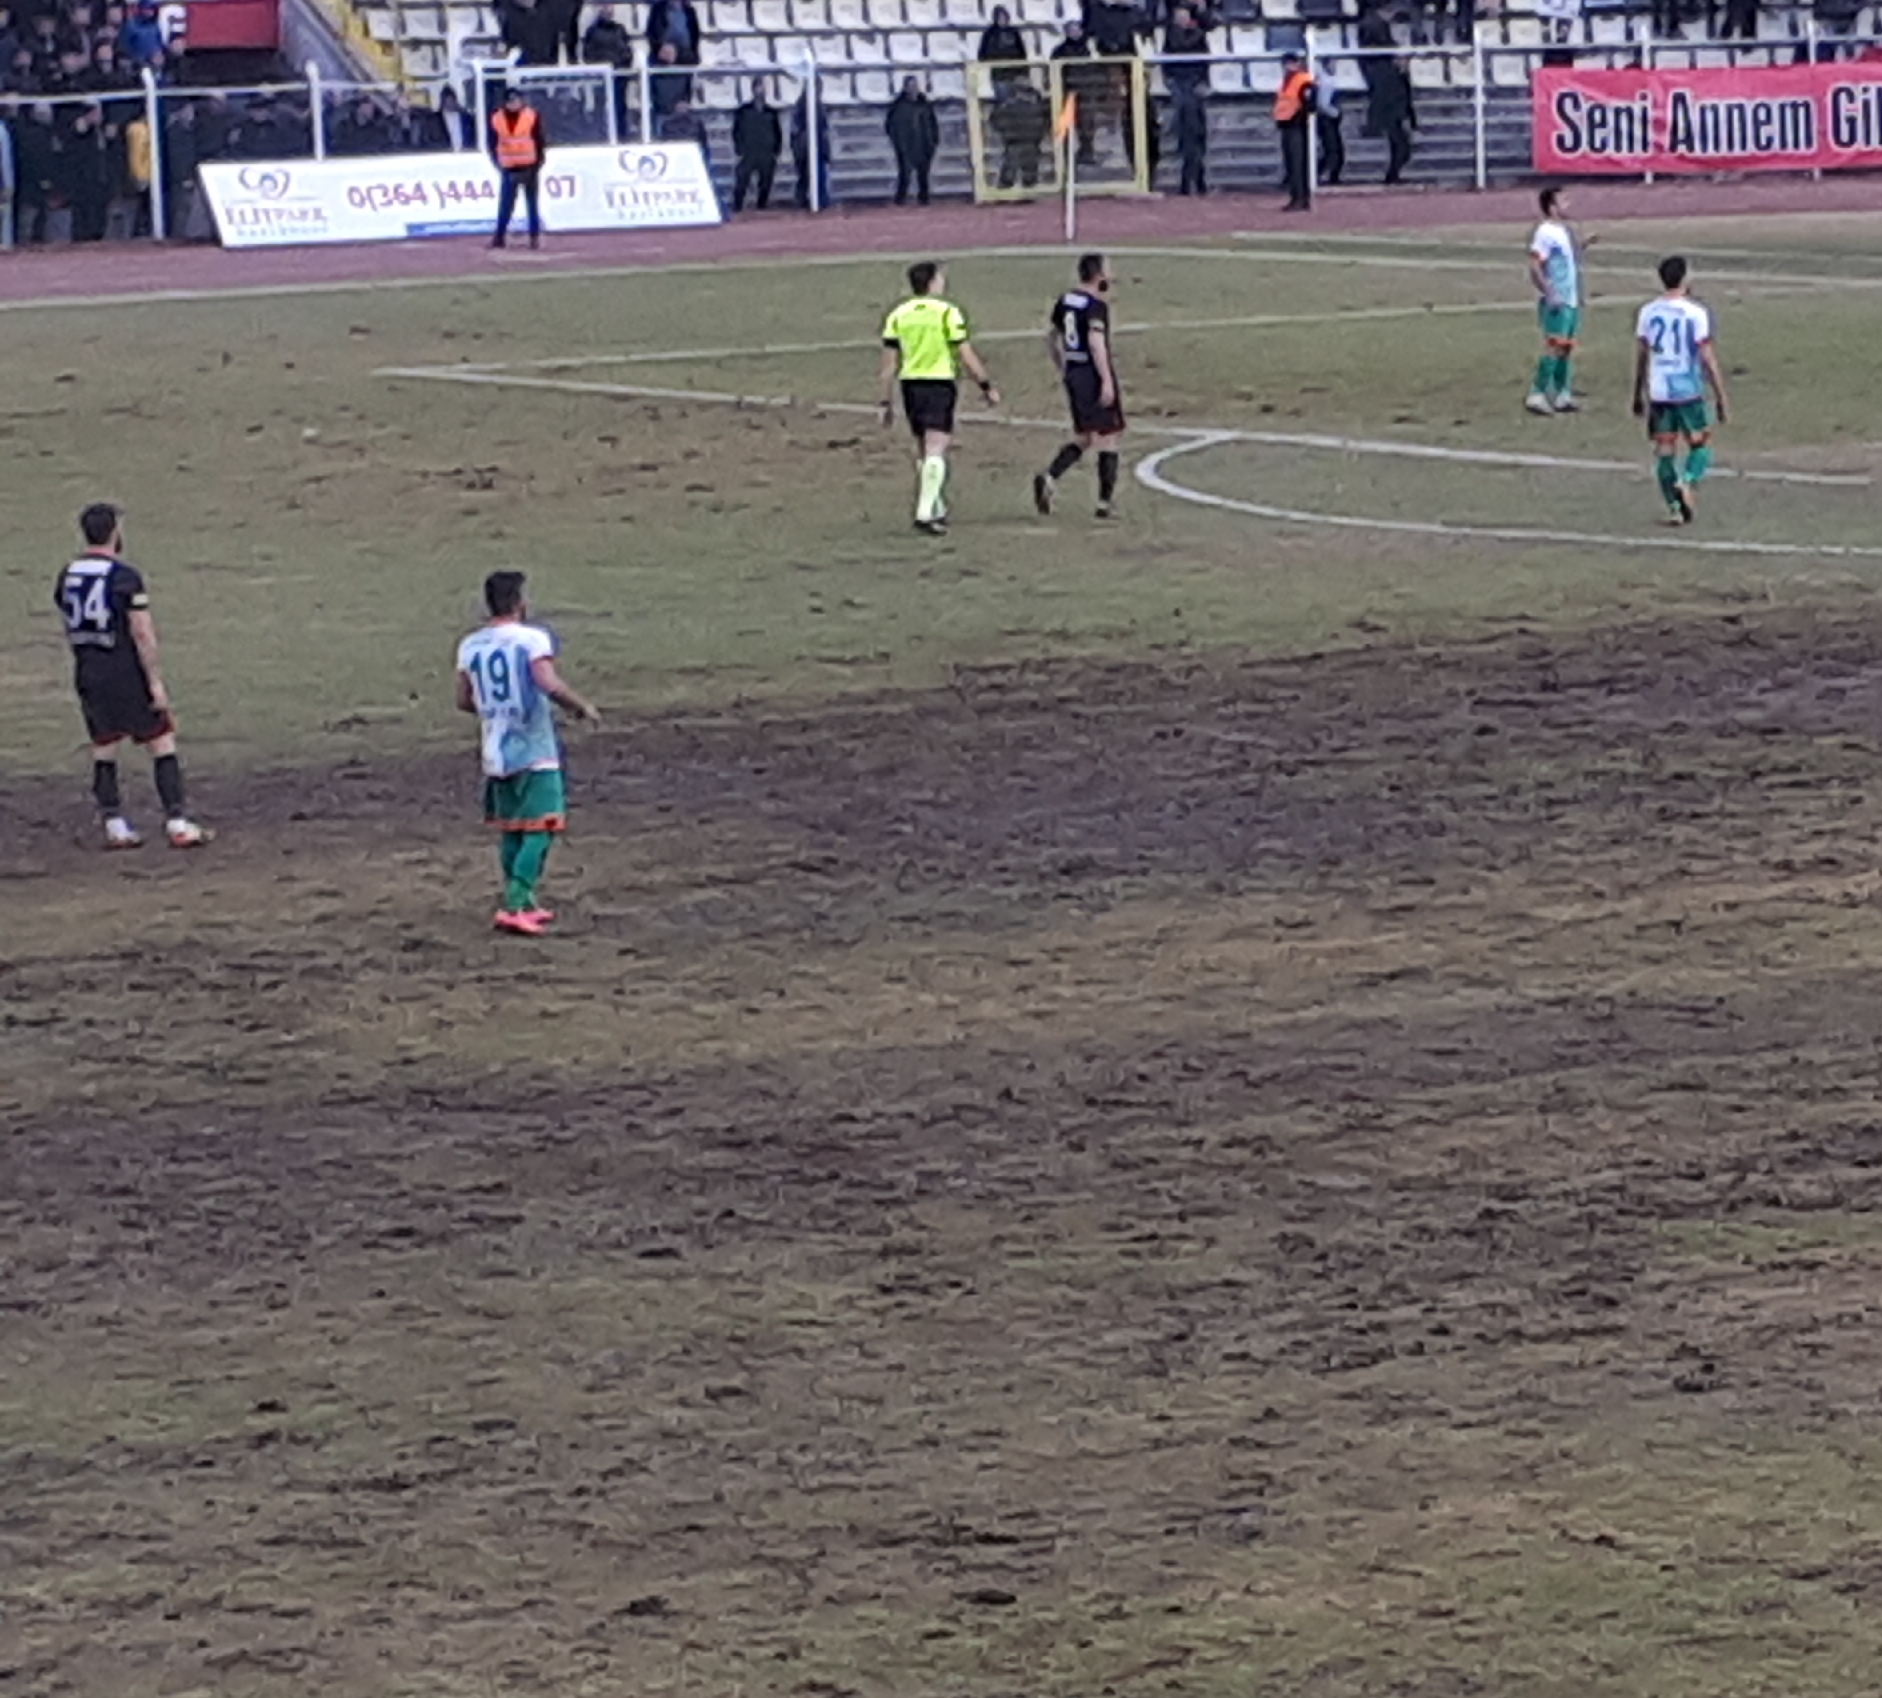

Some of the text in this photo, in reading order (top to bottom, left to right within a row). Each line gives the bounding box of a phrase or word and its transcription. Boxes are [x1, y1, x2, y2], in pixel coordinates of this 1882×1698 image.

[1554, 90, 1652, 155] Seni
[1668, 90, 1814, 155] Annem
[1649, 315, 1682, 356] 21
[63, 575, 111, 631] 54
[470, 648, 511, 705] 19
